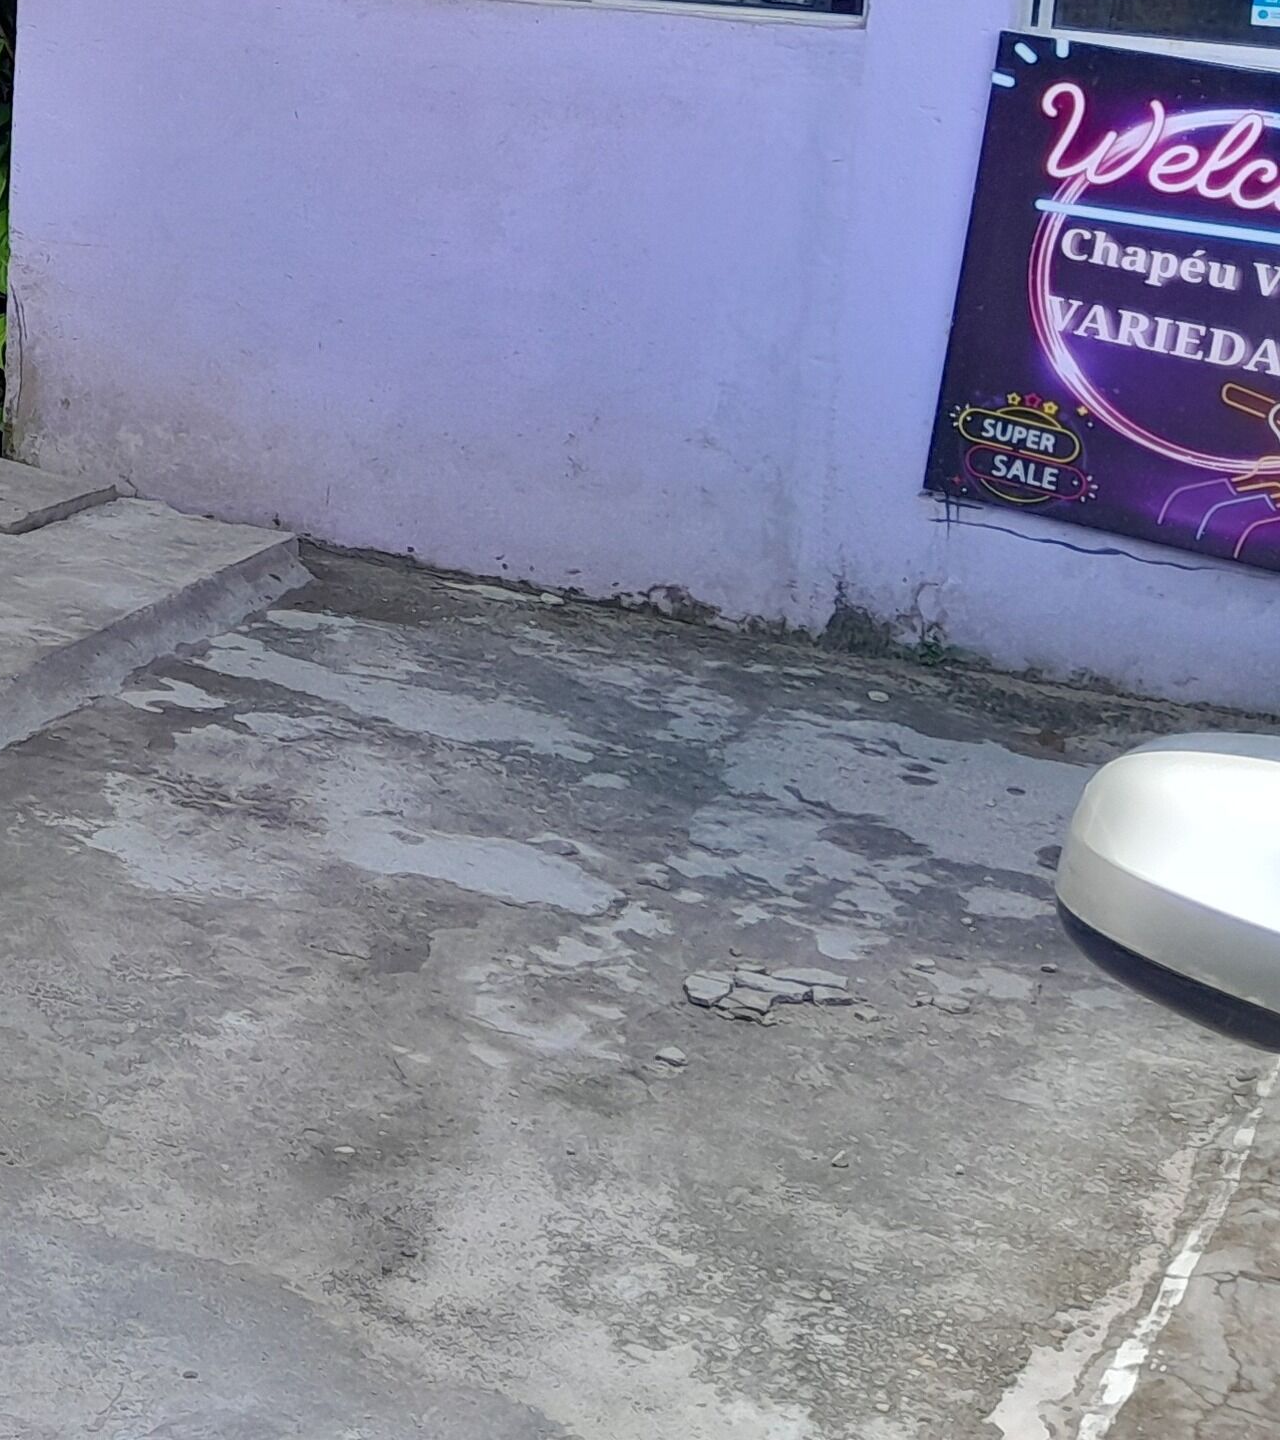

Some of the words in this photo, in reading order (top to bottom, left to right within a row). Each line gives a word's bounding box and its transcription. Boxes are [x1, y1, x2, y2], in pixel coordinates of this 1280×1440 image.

[1042, 82, 1280, 210] Welc
[1061, 228, 1237, 291] Chapéu
[981, 418, 1055, 453] SUPER
[991, 455, 1059, 490] SALE
